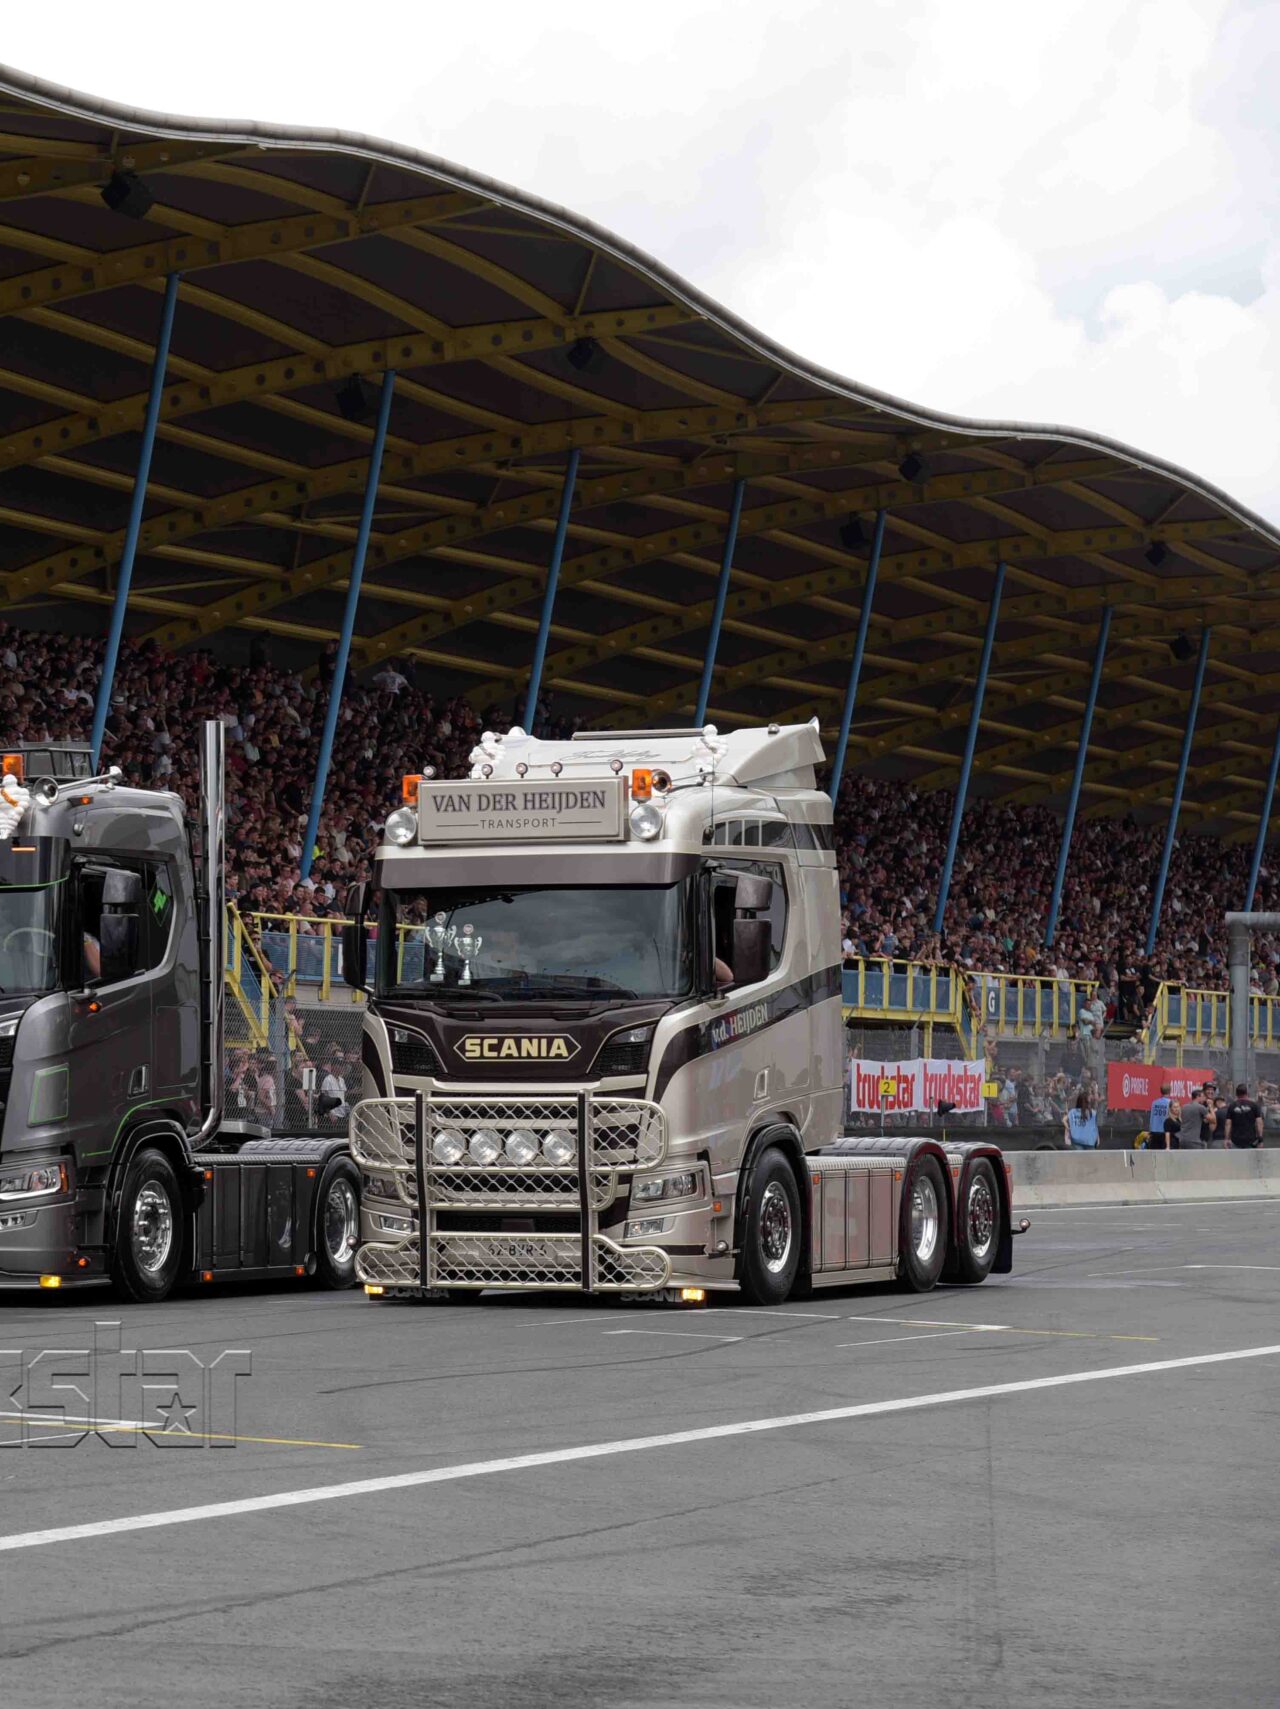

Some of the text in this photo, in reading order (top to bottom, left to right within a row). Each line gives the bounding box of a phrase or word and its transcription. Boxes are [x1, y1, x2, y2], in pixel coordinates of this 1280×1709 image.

[432, 790, 606, 814] VAN DER HEIJDEN
[480, 818, 557, 830] TRANSPORT
[988, 991, 996, 1013] G
[729, 1002, 769, 1036] HEIJDEN
[464, 1038, 569, 1057] SCANIA
[883, 1082, 891, 1094] 2
[923, 1062, 982, 1111] truckstar
